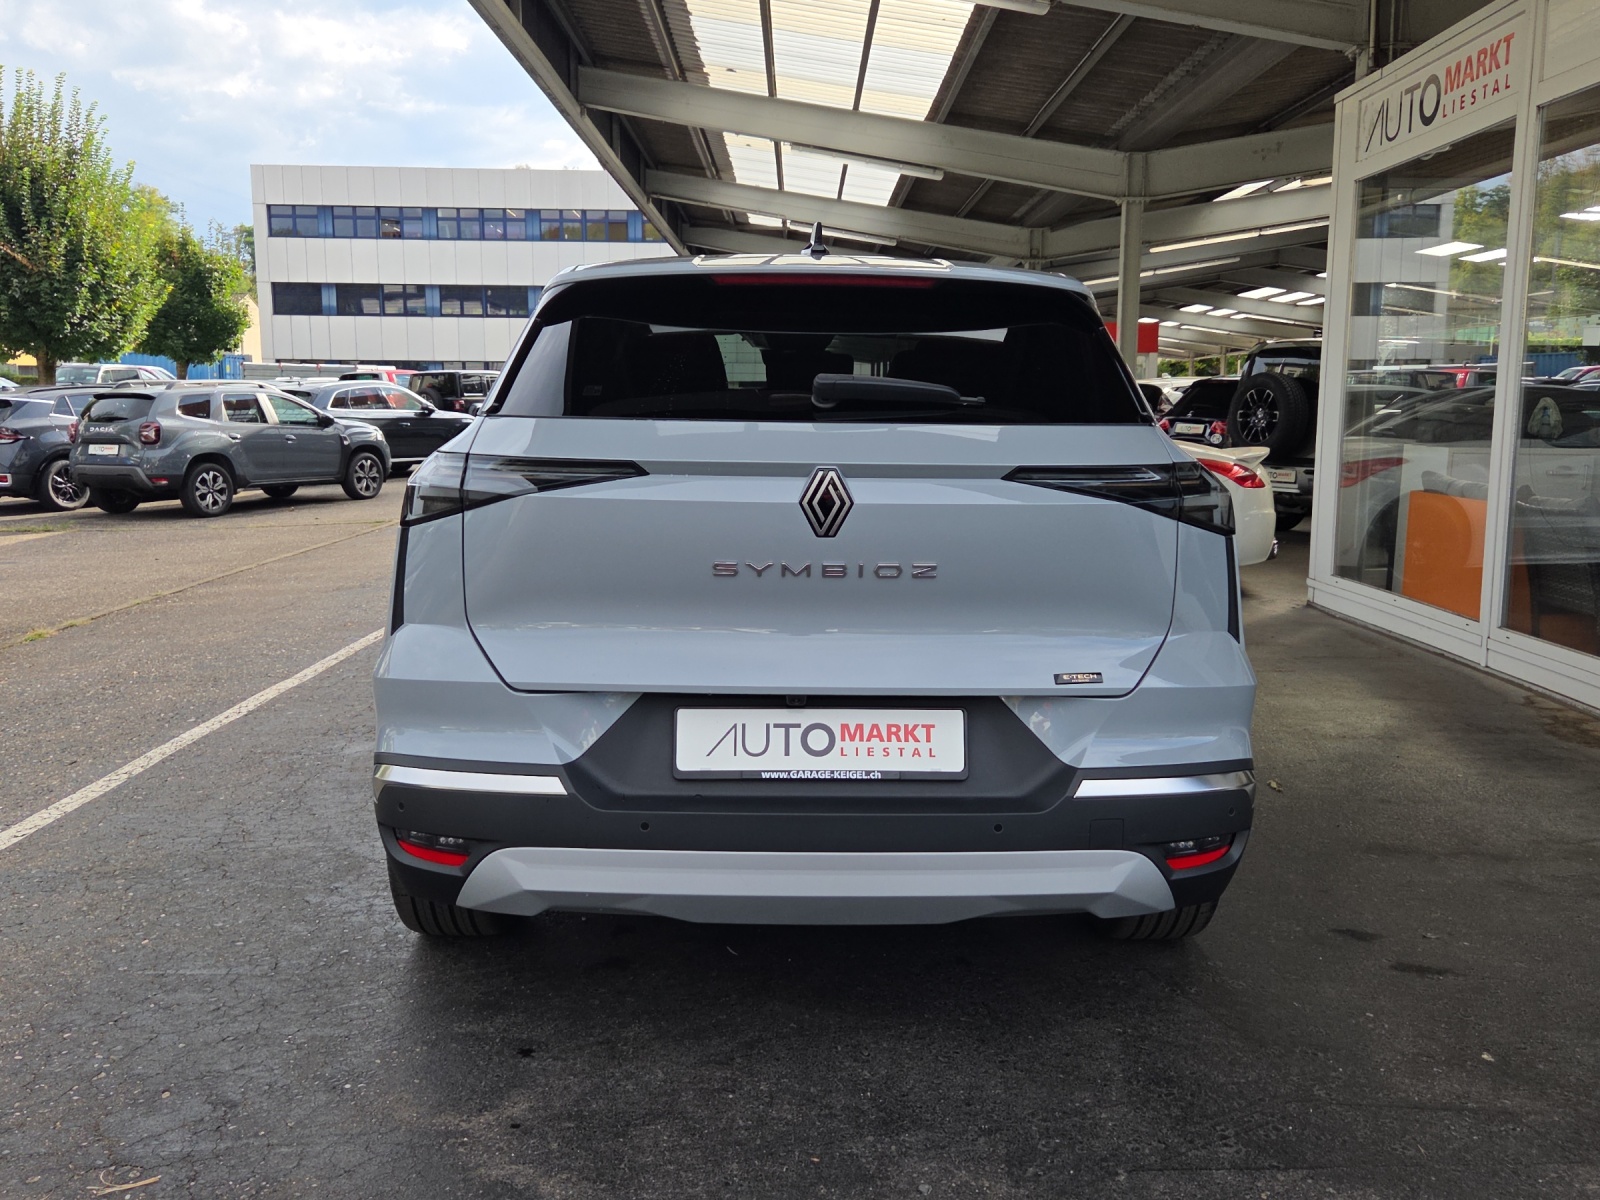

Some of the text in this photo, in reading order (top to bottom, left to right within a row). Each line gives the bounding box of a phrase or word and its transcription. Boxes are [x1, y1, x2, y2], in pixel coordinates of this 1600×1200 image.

[1365, 32, 1515, 152] AUTO MARKT
[1442, 74, 1511, 118] LIESTAL
[712, 562, 937, 578] SYMBIOZ
[706, 722, 935, 757] AUTO MARKT
[840, 747, 936, 758] LIESTAL
[761, 770, 881, 780] www.GARAGE-KEIGEL.ch
